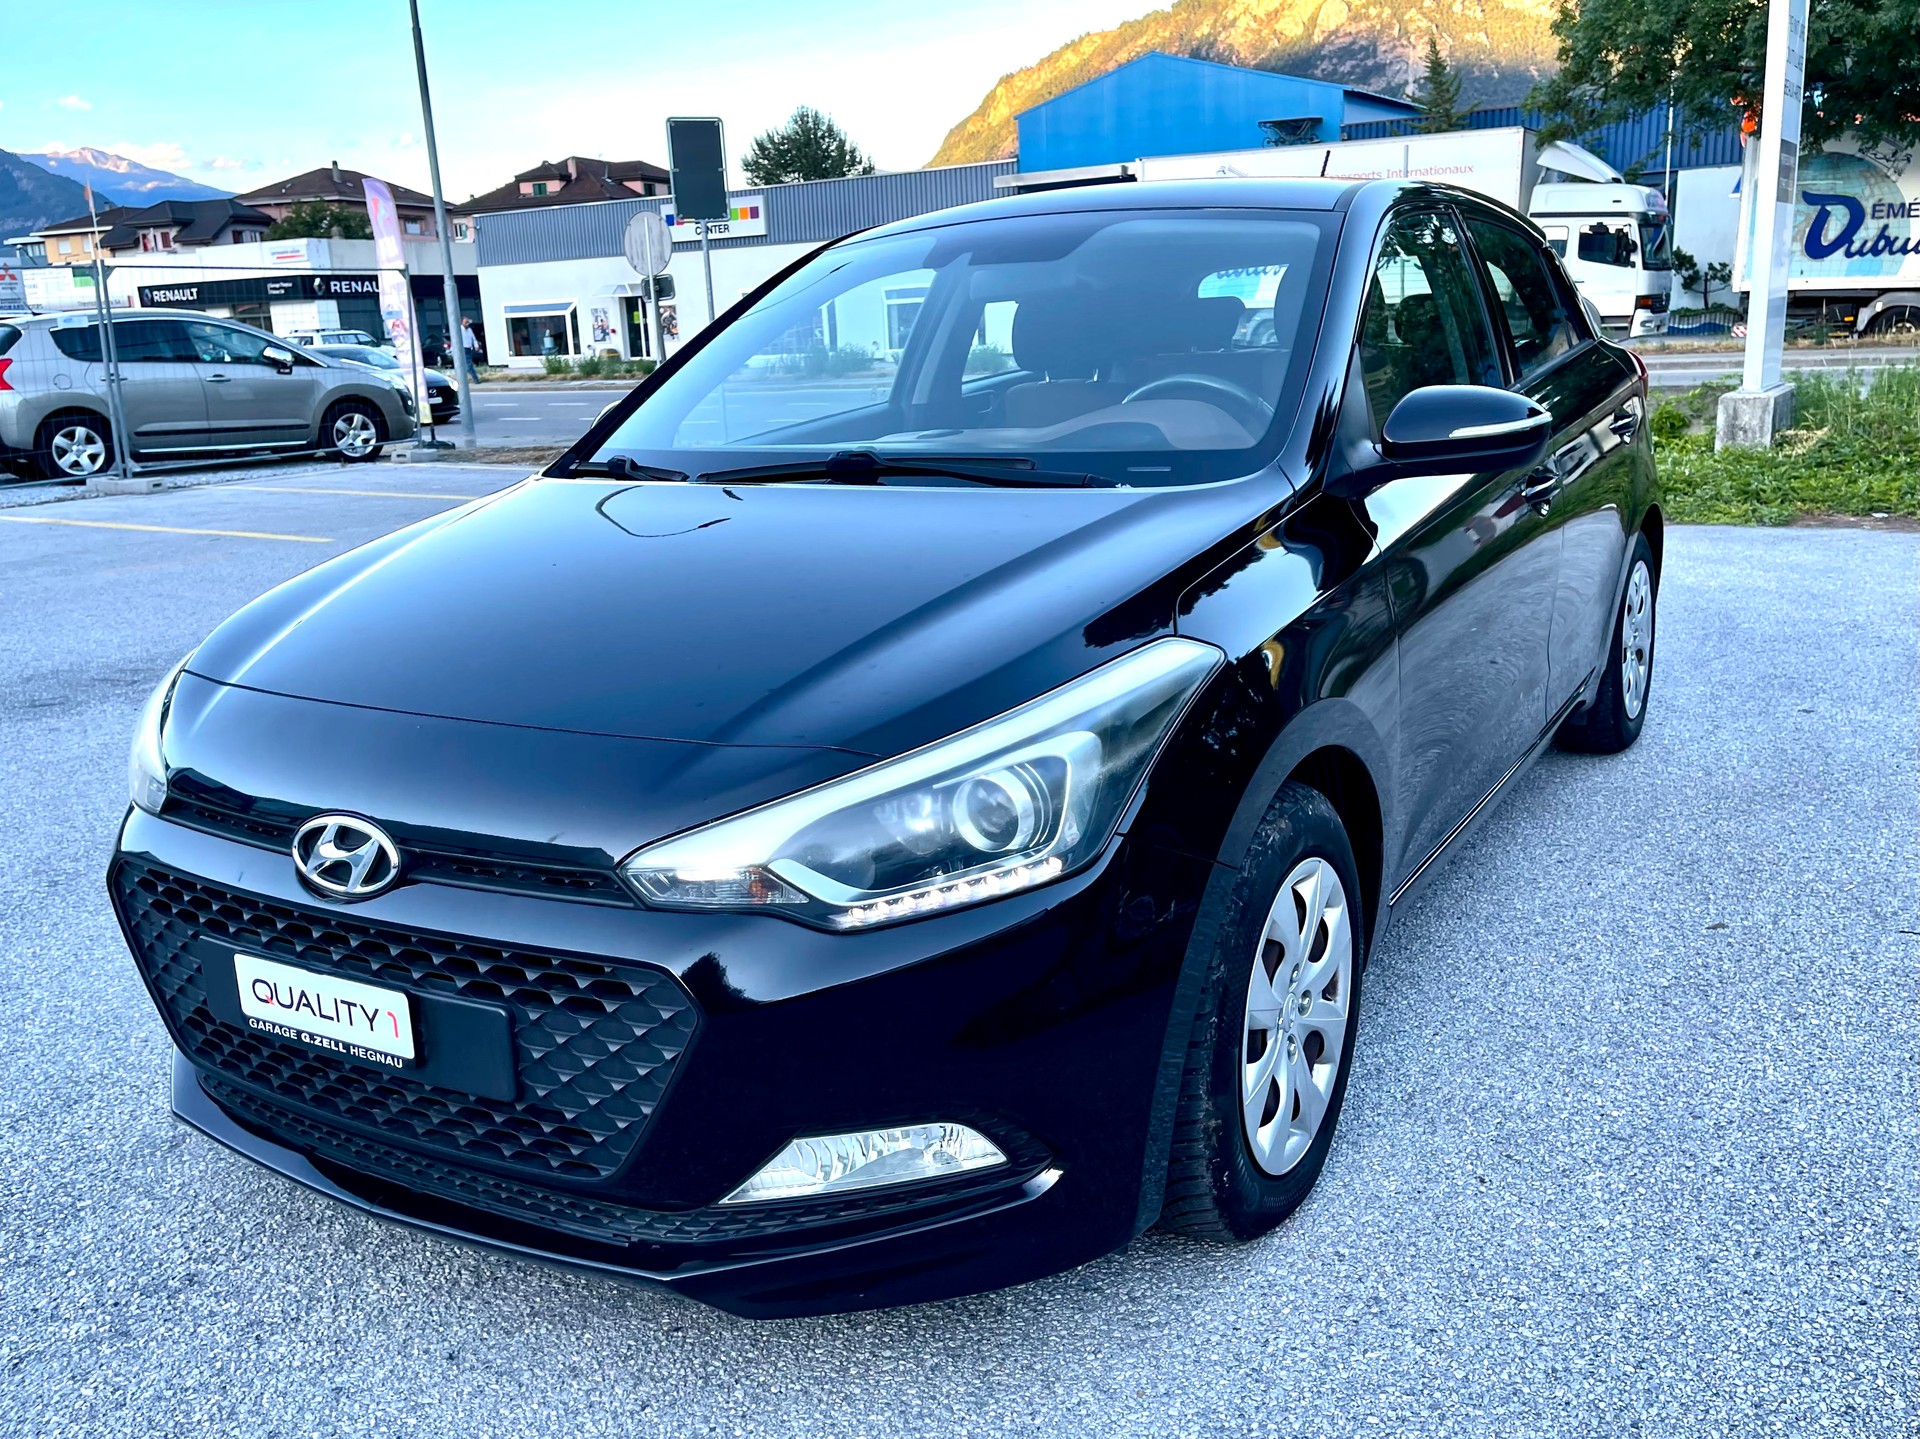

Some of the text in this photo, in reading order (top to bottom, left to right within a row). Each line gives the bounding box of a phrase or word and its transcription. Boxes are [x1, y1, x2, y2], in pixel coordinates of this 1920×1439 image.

[1386, 165, 1474, 179] Intrnationaux
[695, 223, 730, 236] CNTER
[330, 280, 380, 293] RENAU
[152, 287, 198, 303] RENAULT
[252, 978, 399, 1038] QUALITY 1
[249, 1018, 403, 1068] GARAGE G.ZELL HEGNAU
